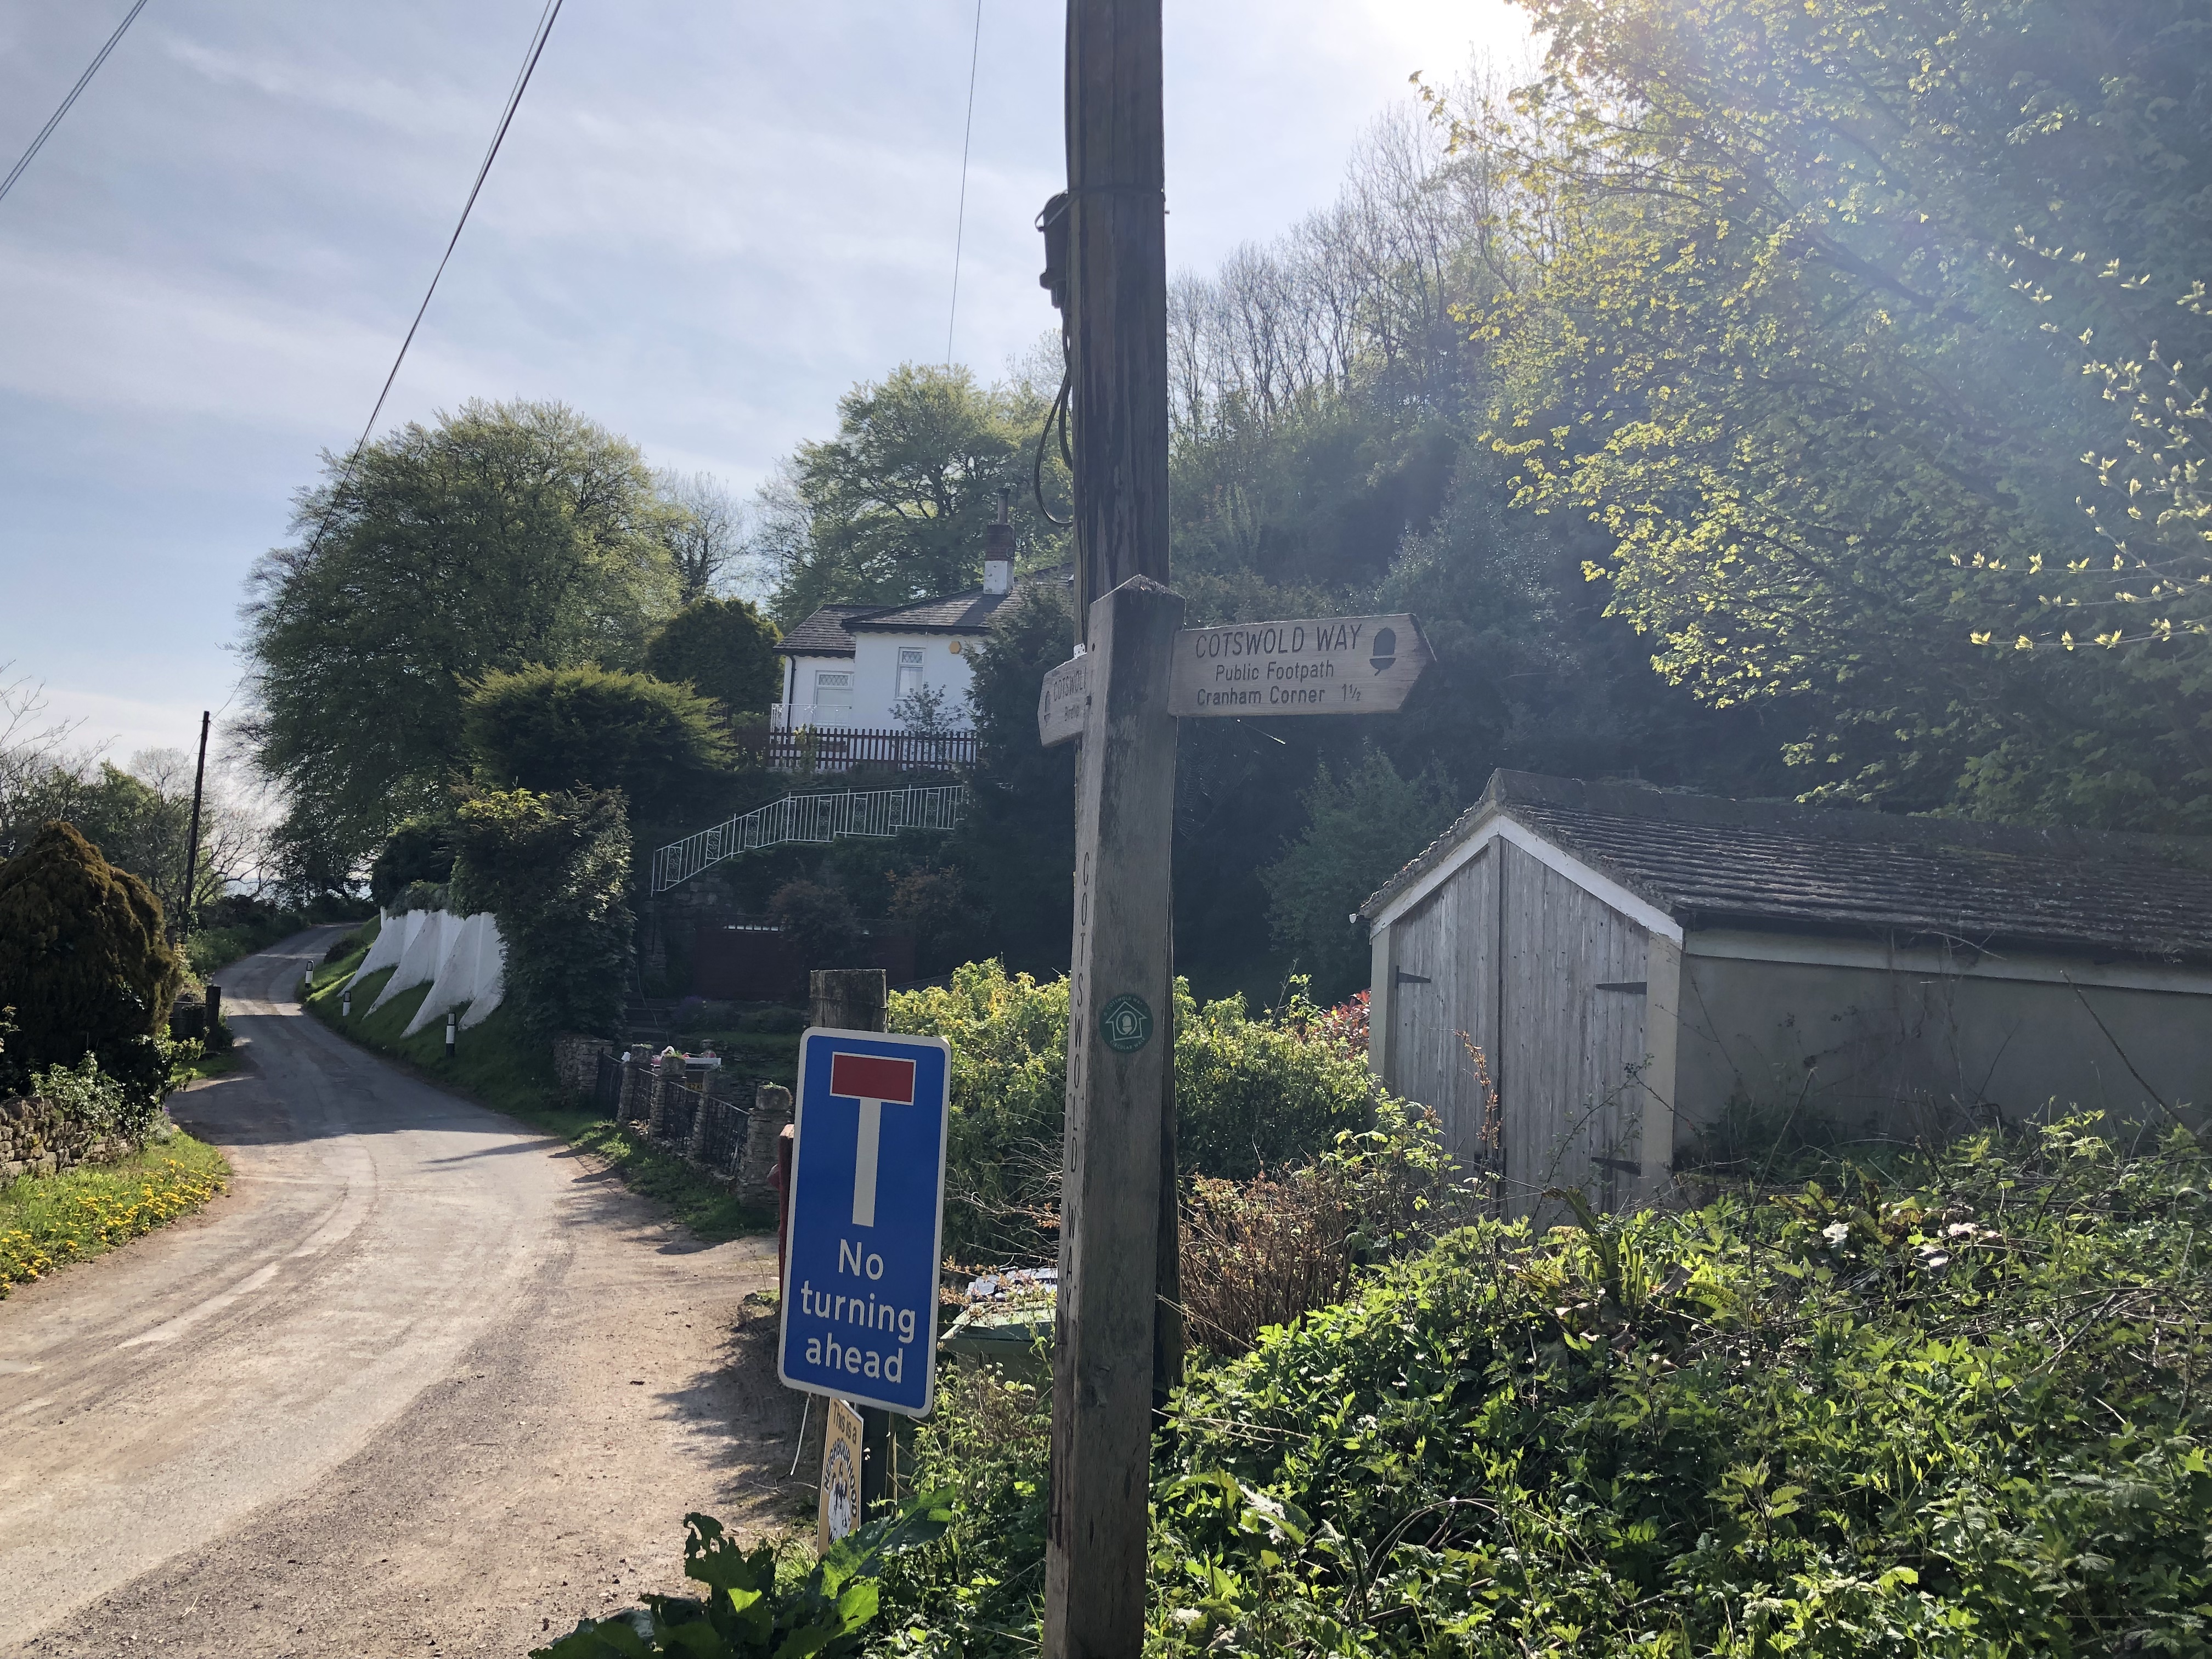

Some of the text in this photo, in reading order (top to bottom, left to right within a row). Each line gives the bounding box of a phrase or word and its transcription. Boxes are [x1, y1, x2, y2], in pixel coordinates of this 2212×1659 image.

[1196, 623, 1362, 659] COTSWOLD WAY
[1053, 667, 1087, 702] COTSWOL
[1215, 659, 1334, 683] Public Footpath
[1197, 687, 1262, 706] Cranham
[1269, 685, 1326, 704] Corner
[1107, 996, 1131, 1009] COTSWOLD
[1110, 1037, 1146, 1050] CIRCULAR WALK
[1066, 851, 1090, 1323] COTSWOLD WAY
[838, 1238, 884, 1280] No
[800, 1280, 916, 1344] turning
[805, 1333, 904, 1384] ahead
[833, 1401, 857, 1445] This is a
